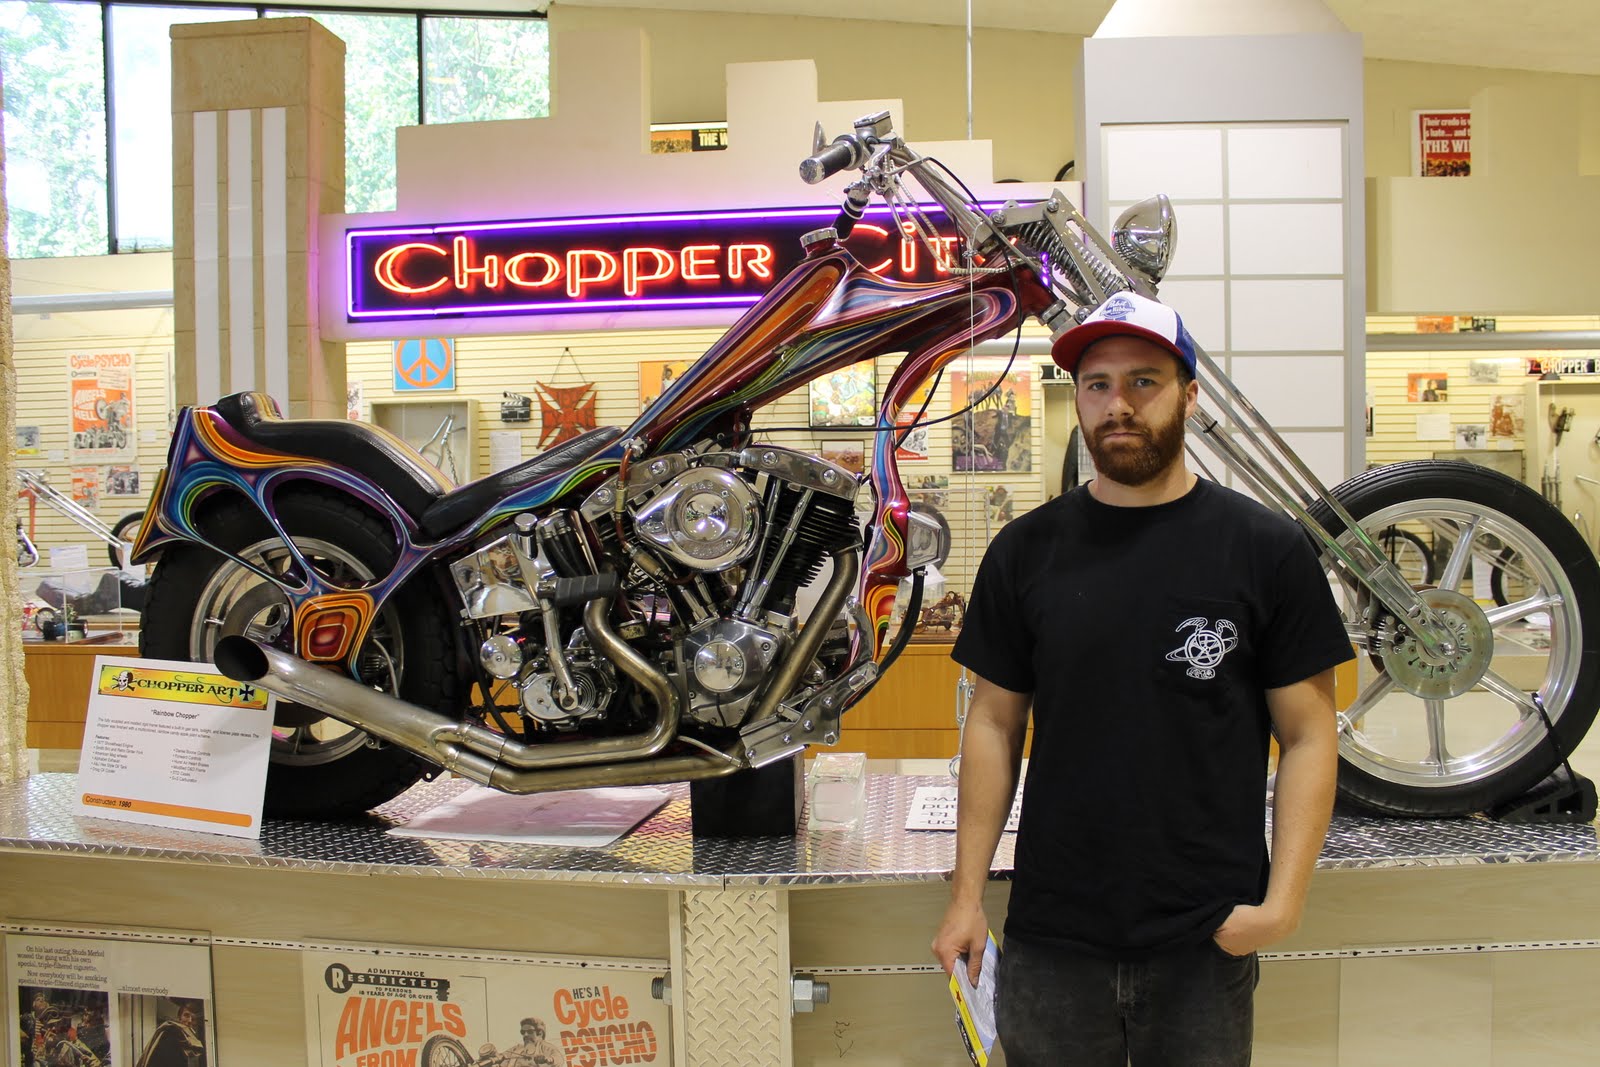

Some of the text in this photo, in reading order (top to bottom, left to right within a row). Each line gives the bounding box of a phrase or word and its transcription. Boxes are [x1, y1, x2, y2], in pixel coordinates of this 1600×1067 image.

[699, 133, 718, 146] THE
[1423, 140, 1449, 152] THE
[1541, 359, 1588, 374] CHOPPER
[137, 678, 238, 702] CHOPPER ART
[40, 972, 65, 980] everybody
[331, 968, 439, 989] RESTRICTED
[368, 968, 425, 977] ADMITTANCE
[572, 986, 600, 999] HE'S A
[554, 986, 629, 1028] Cycle
[336, 997, 466, 1061] ANGELS
[560, 1021, 657, 1067] PSYCHO
